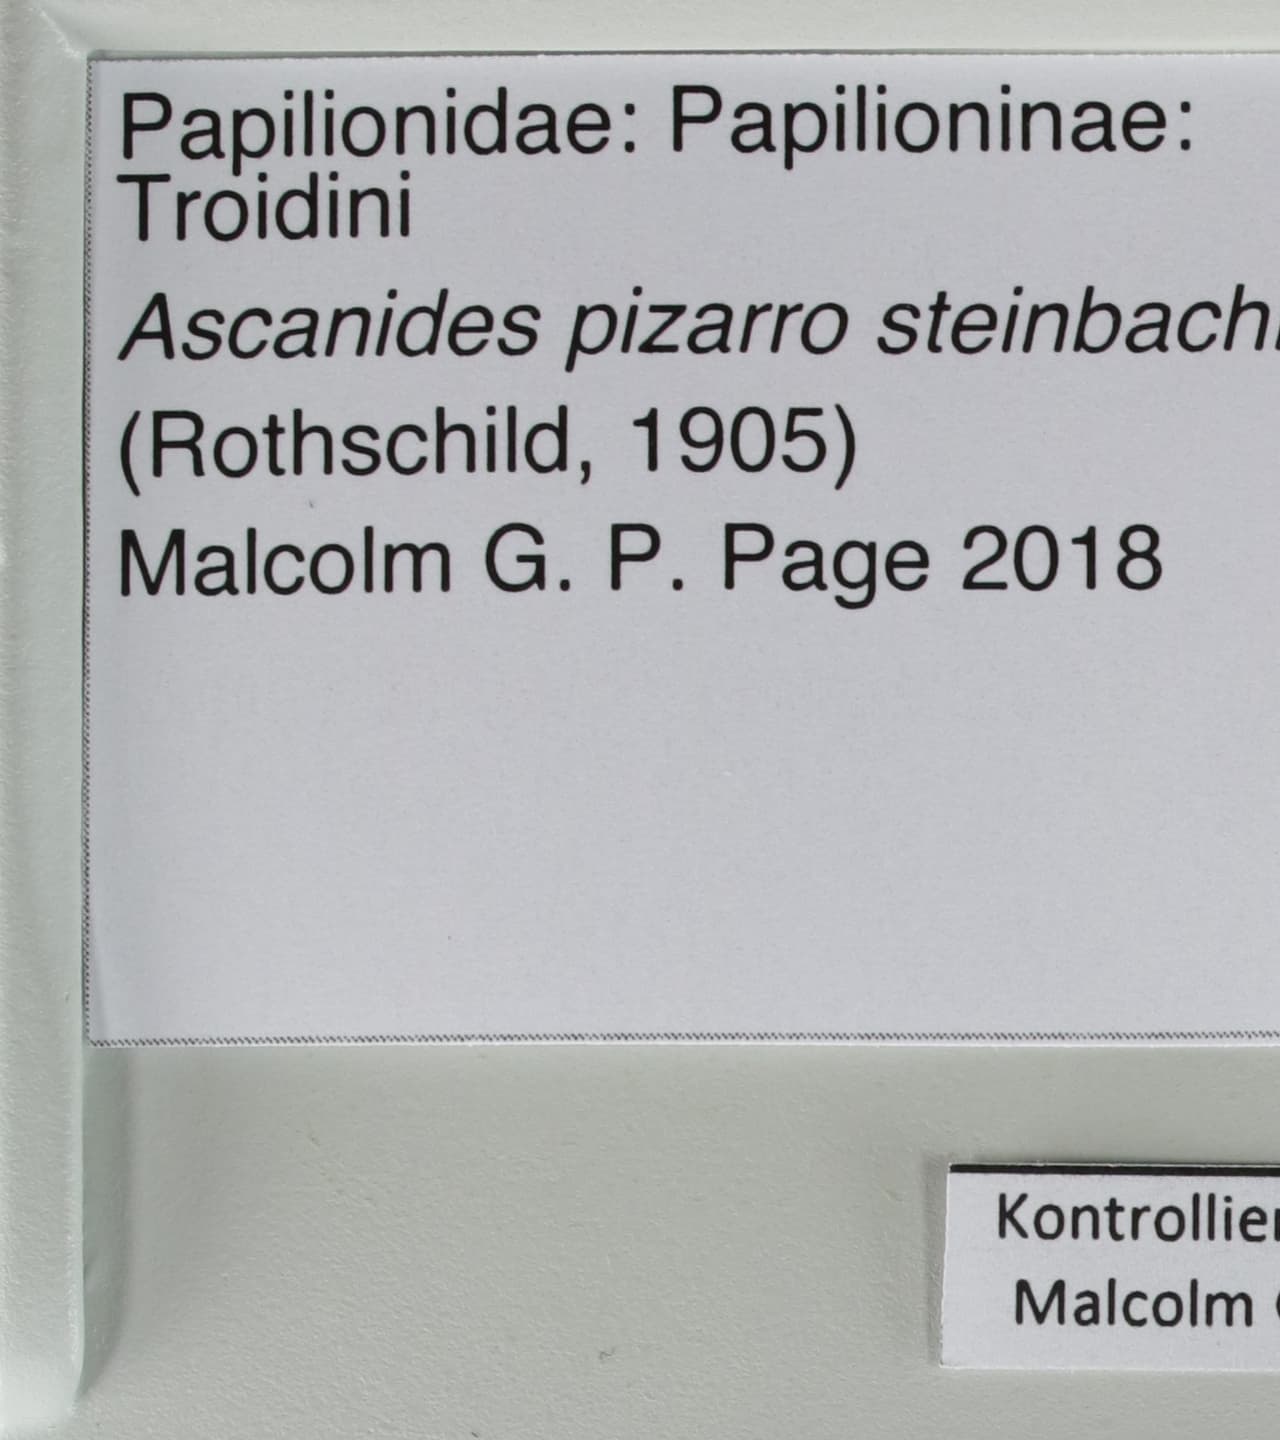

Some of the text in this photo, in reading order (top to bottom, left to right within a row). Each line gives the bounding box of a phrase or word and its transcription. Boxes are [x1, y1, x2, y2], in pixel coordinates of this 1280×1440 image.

[122, 83, 1192, 176] Papilionidae: Papilioninae:
[116, 169, 411, 242] Troidini
[118, 288, 541, 361] Ascanides
[564, 286, 849, 373] pizarro
[120, 404, 857, 490] (Rothschild, 1905)
[120, 522, 1163, 610] Malcolm G. P. Page 2018
[1015, 1277, 1253, 1328] Malcolm
